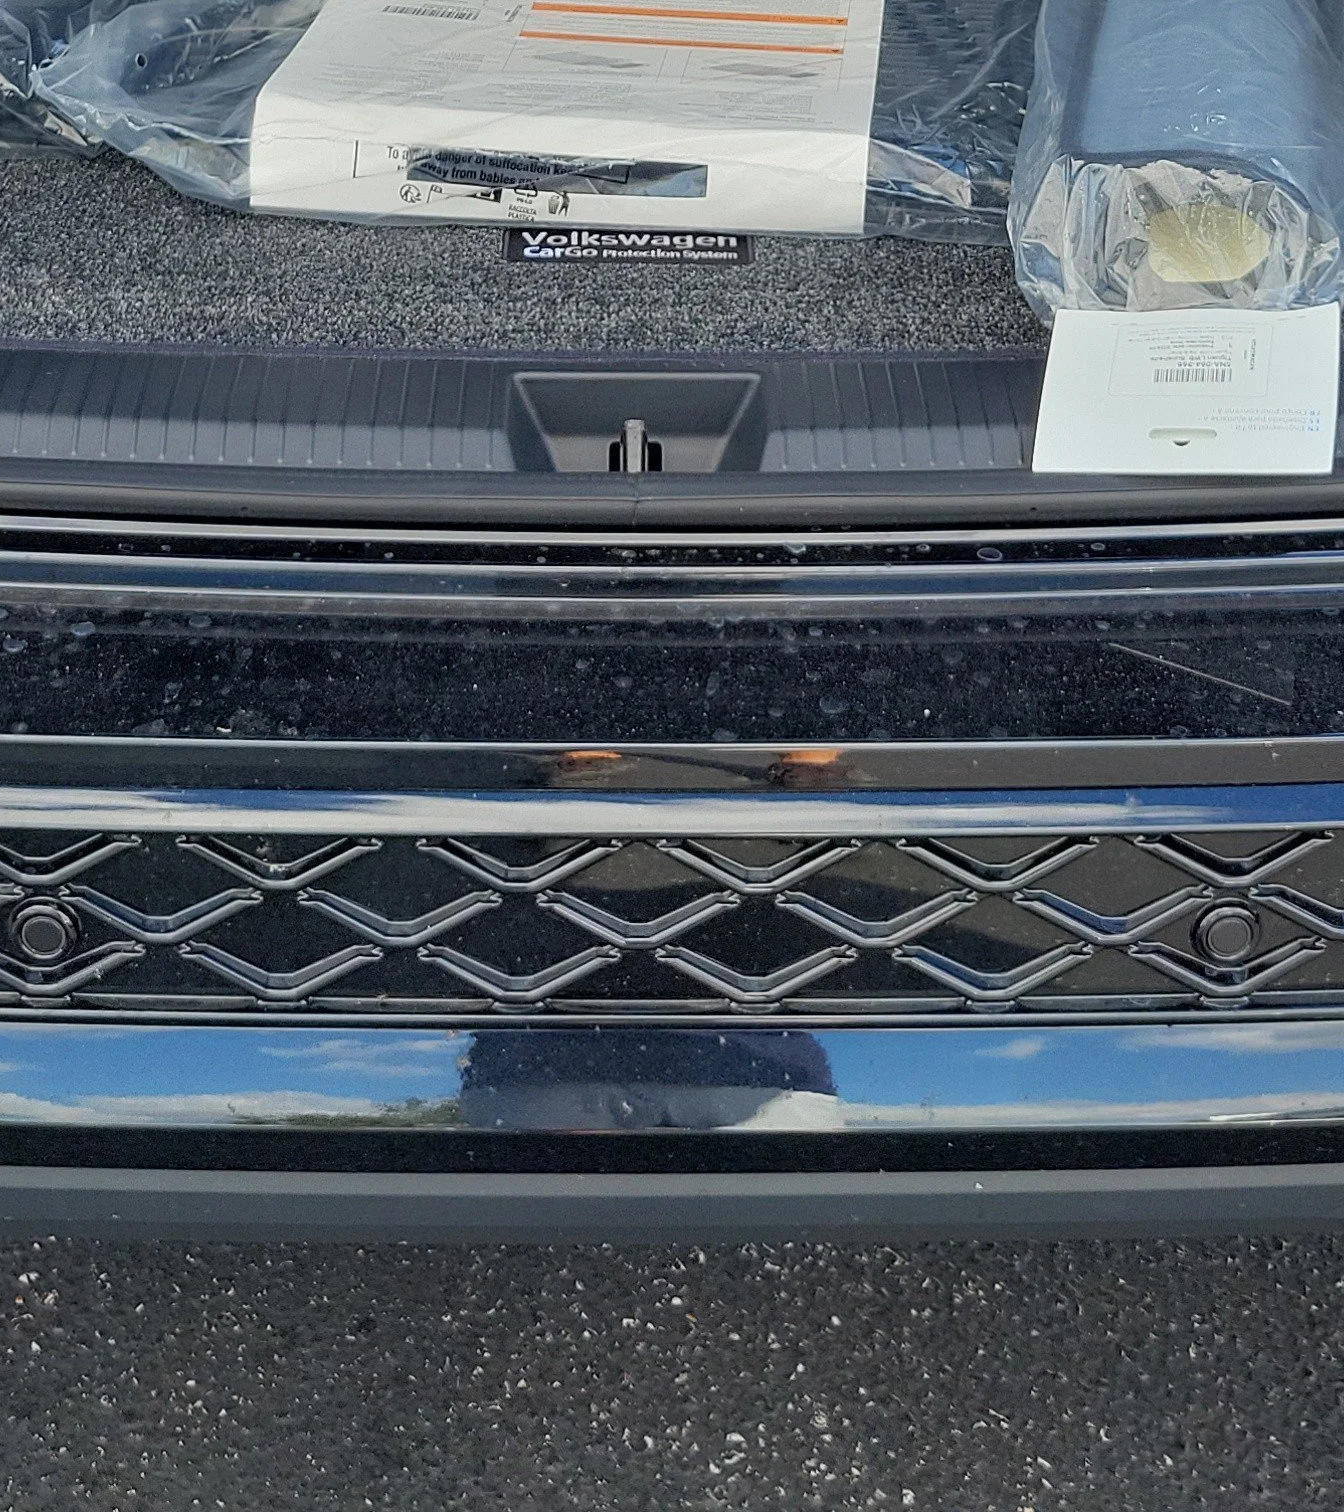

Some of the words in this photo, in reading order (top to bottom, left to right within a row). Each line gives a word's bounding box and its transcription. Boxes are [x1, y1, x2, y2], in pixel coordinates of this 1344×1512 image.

[387, 146, 399, 159] To
[435, 151, 472, 165] danger
[475, 154, 487, 166] of
[489, 156, 551, 175] suffocation
[421, 162, 449, 178] away
[451, 166, 476, 180] from
[479, 170, 515, 184] babies
[521, 230, 738, 249] Volkswagen
[523, 246, 599, 259] CarGo
[602, 248, 681, 259] Protection
[683, 249, 739, 260] System
